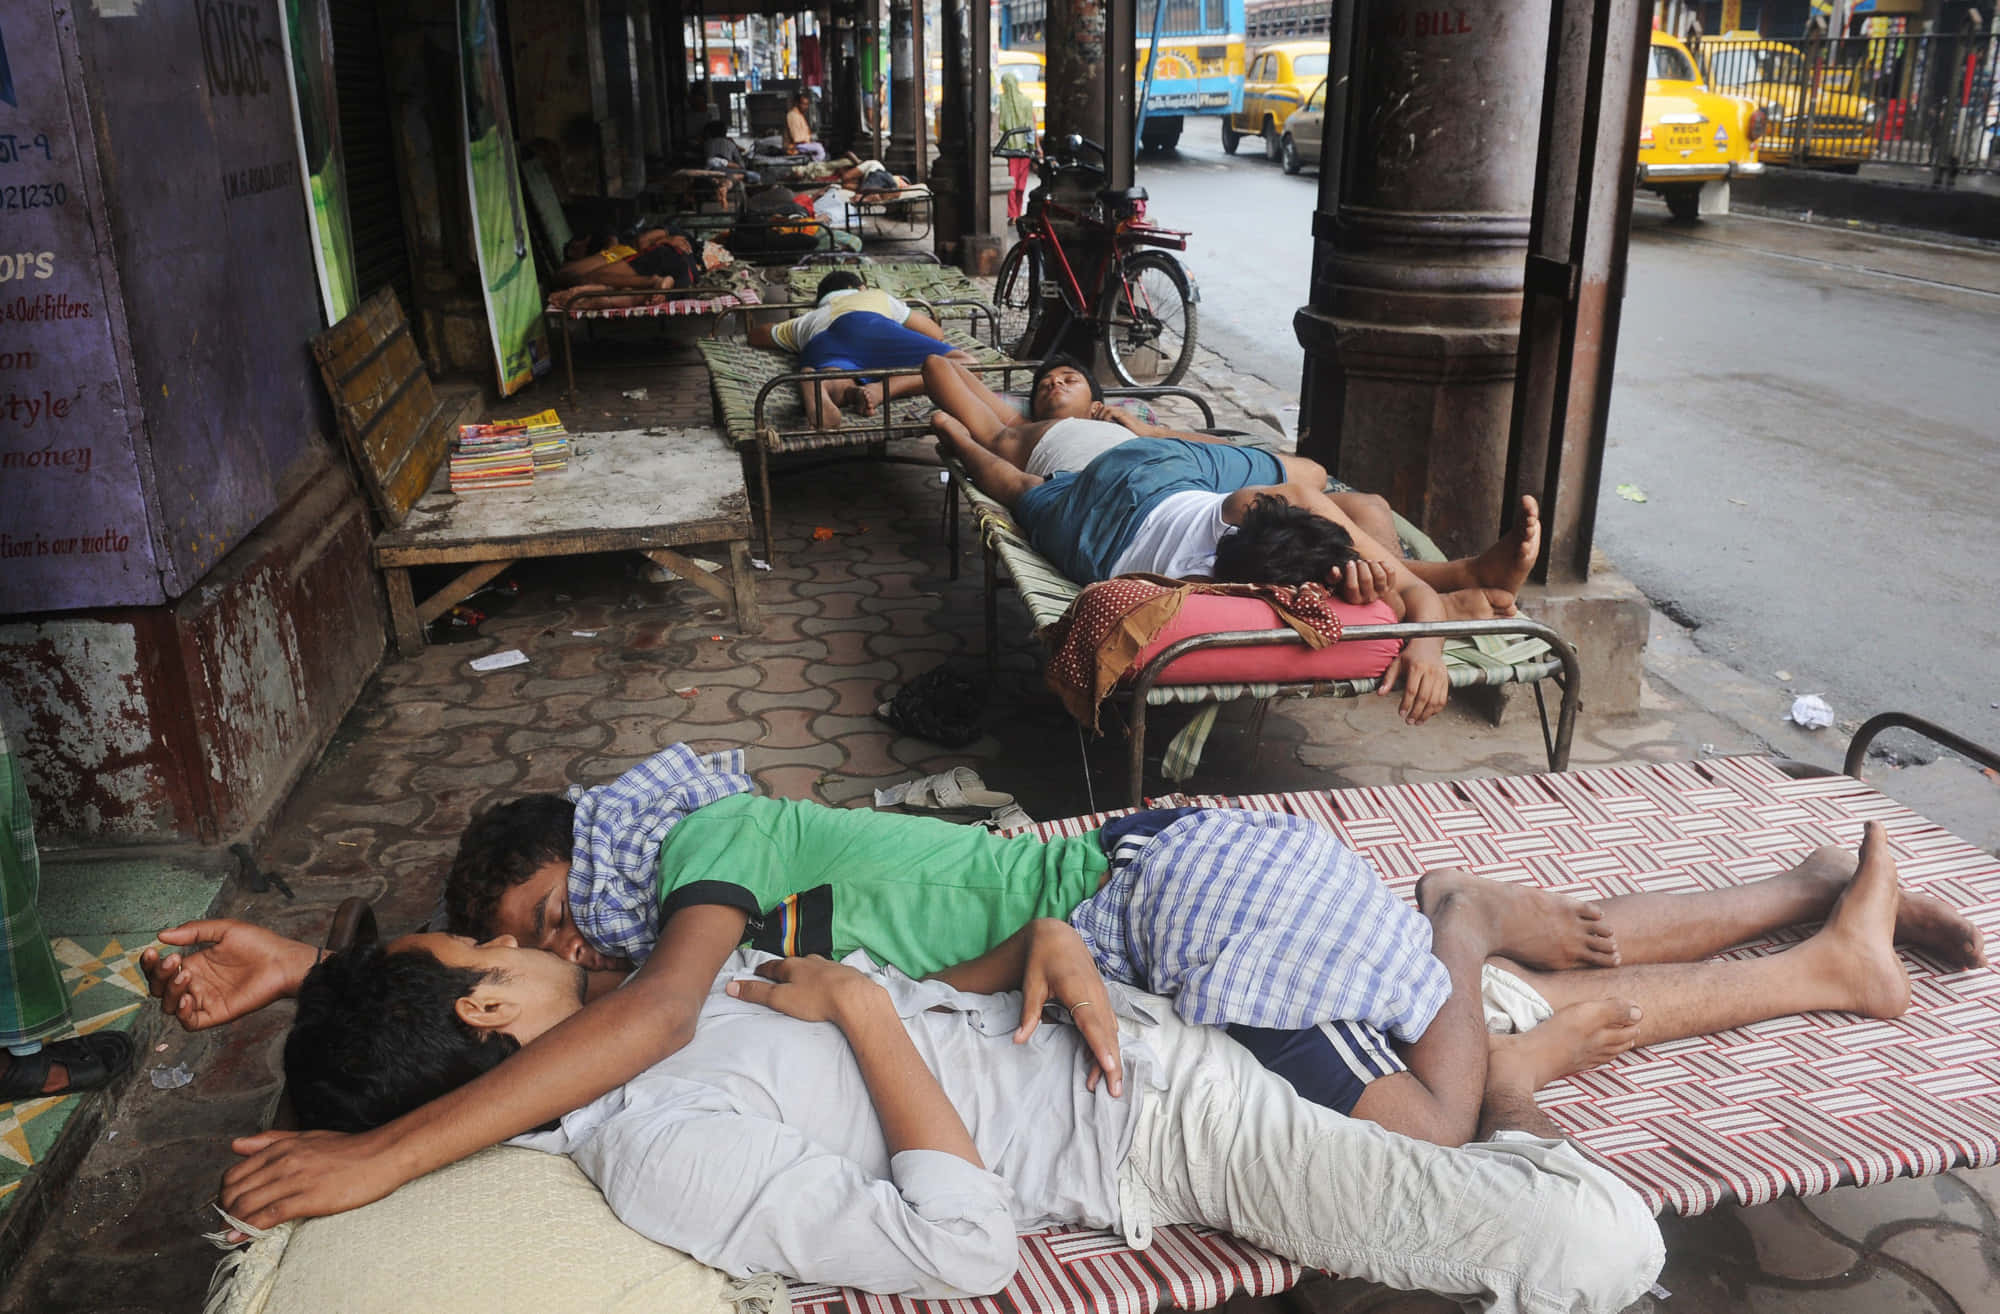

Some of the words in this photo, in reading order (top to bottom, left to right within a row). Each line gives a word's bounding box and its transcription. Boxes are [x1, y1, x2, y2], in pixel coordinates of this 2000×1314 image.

[1415, 11, 1473, 37] BILL
[194, 0, 270, 95] OUSE
[0, 182, 66, 208] 21230
[0, 252, 55, 282] ors
[0, 351, 32, 370] on
[2, 448, 91, 473] money
[52, 537, 77, 554] our
[81, 528, 129, 554] motto
